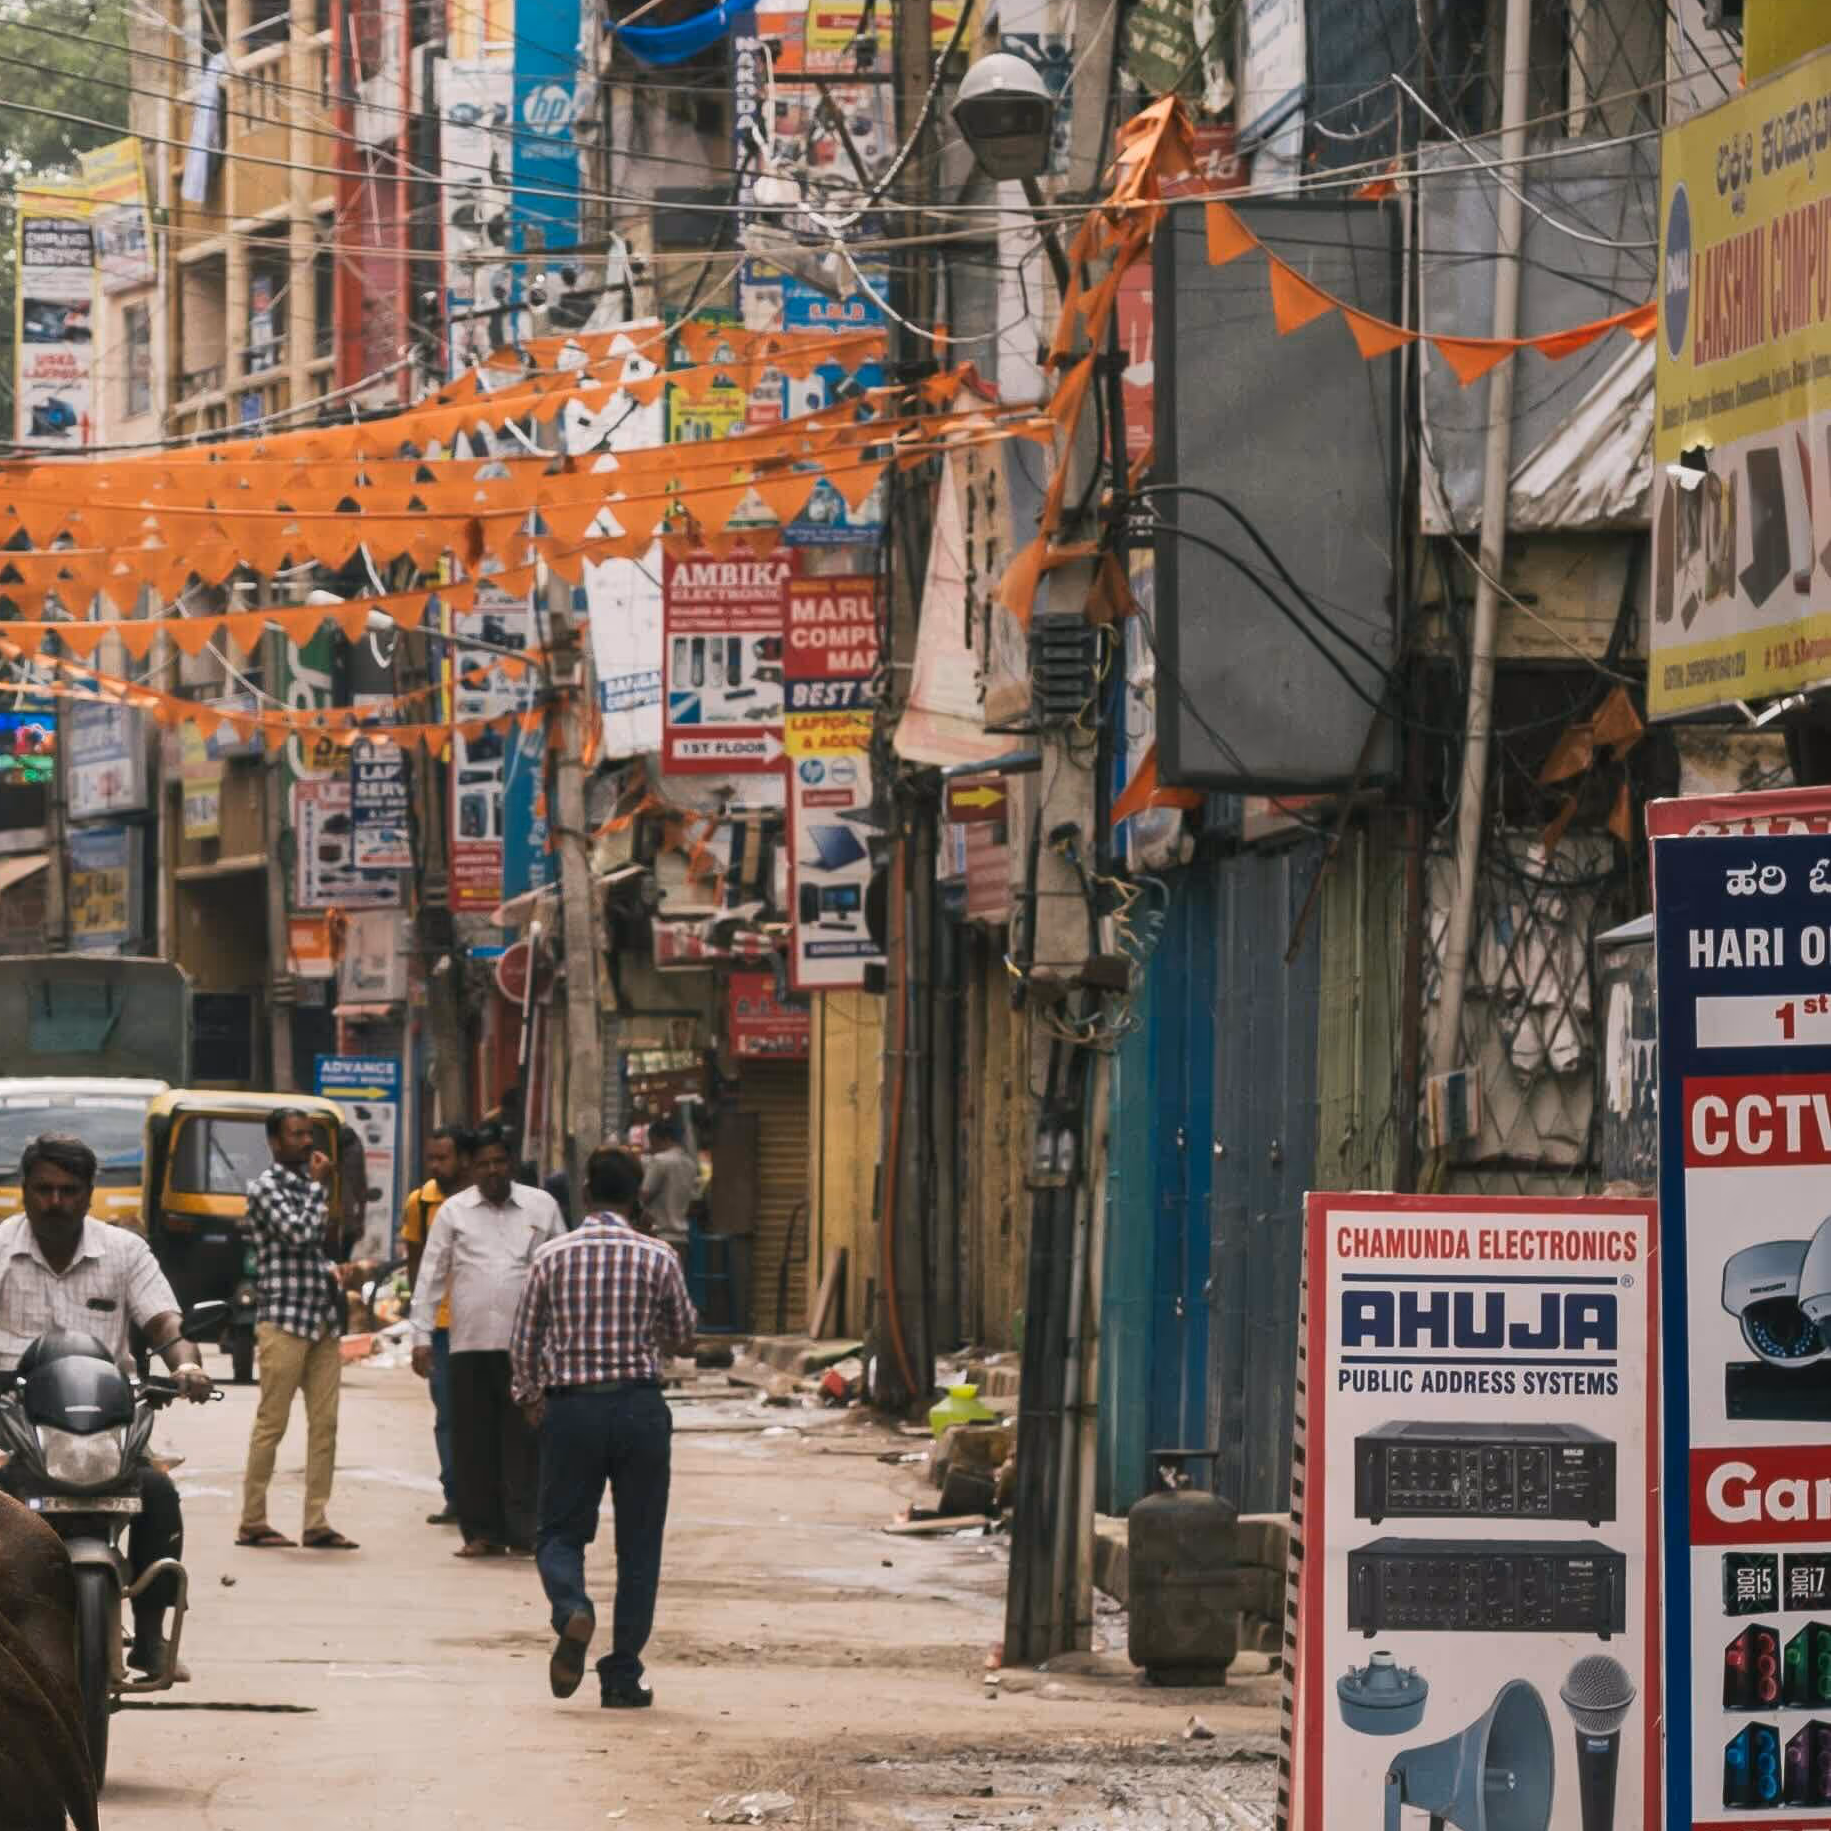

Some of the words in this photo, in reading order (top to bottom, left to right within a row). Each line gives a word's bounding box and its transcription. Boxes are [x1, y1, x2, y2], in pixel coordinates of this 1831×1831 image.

[1694, 224, 1766, 369] LAKSHMI
[671, 562, 791, 587] AMBIKA
[792, 681, 857, 708] BEST
[1726, 860, 1787, 897] ಹರಿ
[1688, 927, 1785, 969] HARI
[1800, 925, 1831, 967] O
[1690, 1092, 1831, 1156] CCTV
[1336, 1226, 1470, 1260] CHAMUNDA
[1478, 1229, 1638, 1262] ELECTRONICS
[1340, 1289, 1618, 1351] AHUJA
[1338, 1369, 1414, 1394] PUBLIC
[1420, 1370, 1517, 1395] ADDRESS
[1523, 1371, 1619, 1396] SYSTEMS
[1737, 1569, 1756, 1602] CORE
[1756, 1568, 1772, 1594] i5
[1791, 1567, 1809, 1600] CORE
[1810, 1567, 1826, 1593] i7
